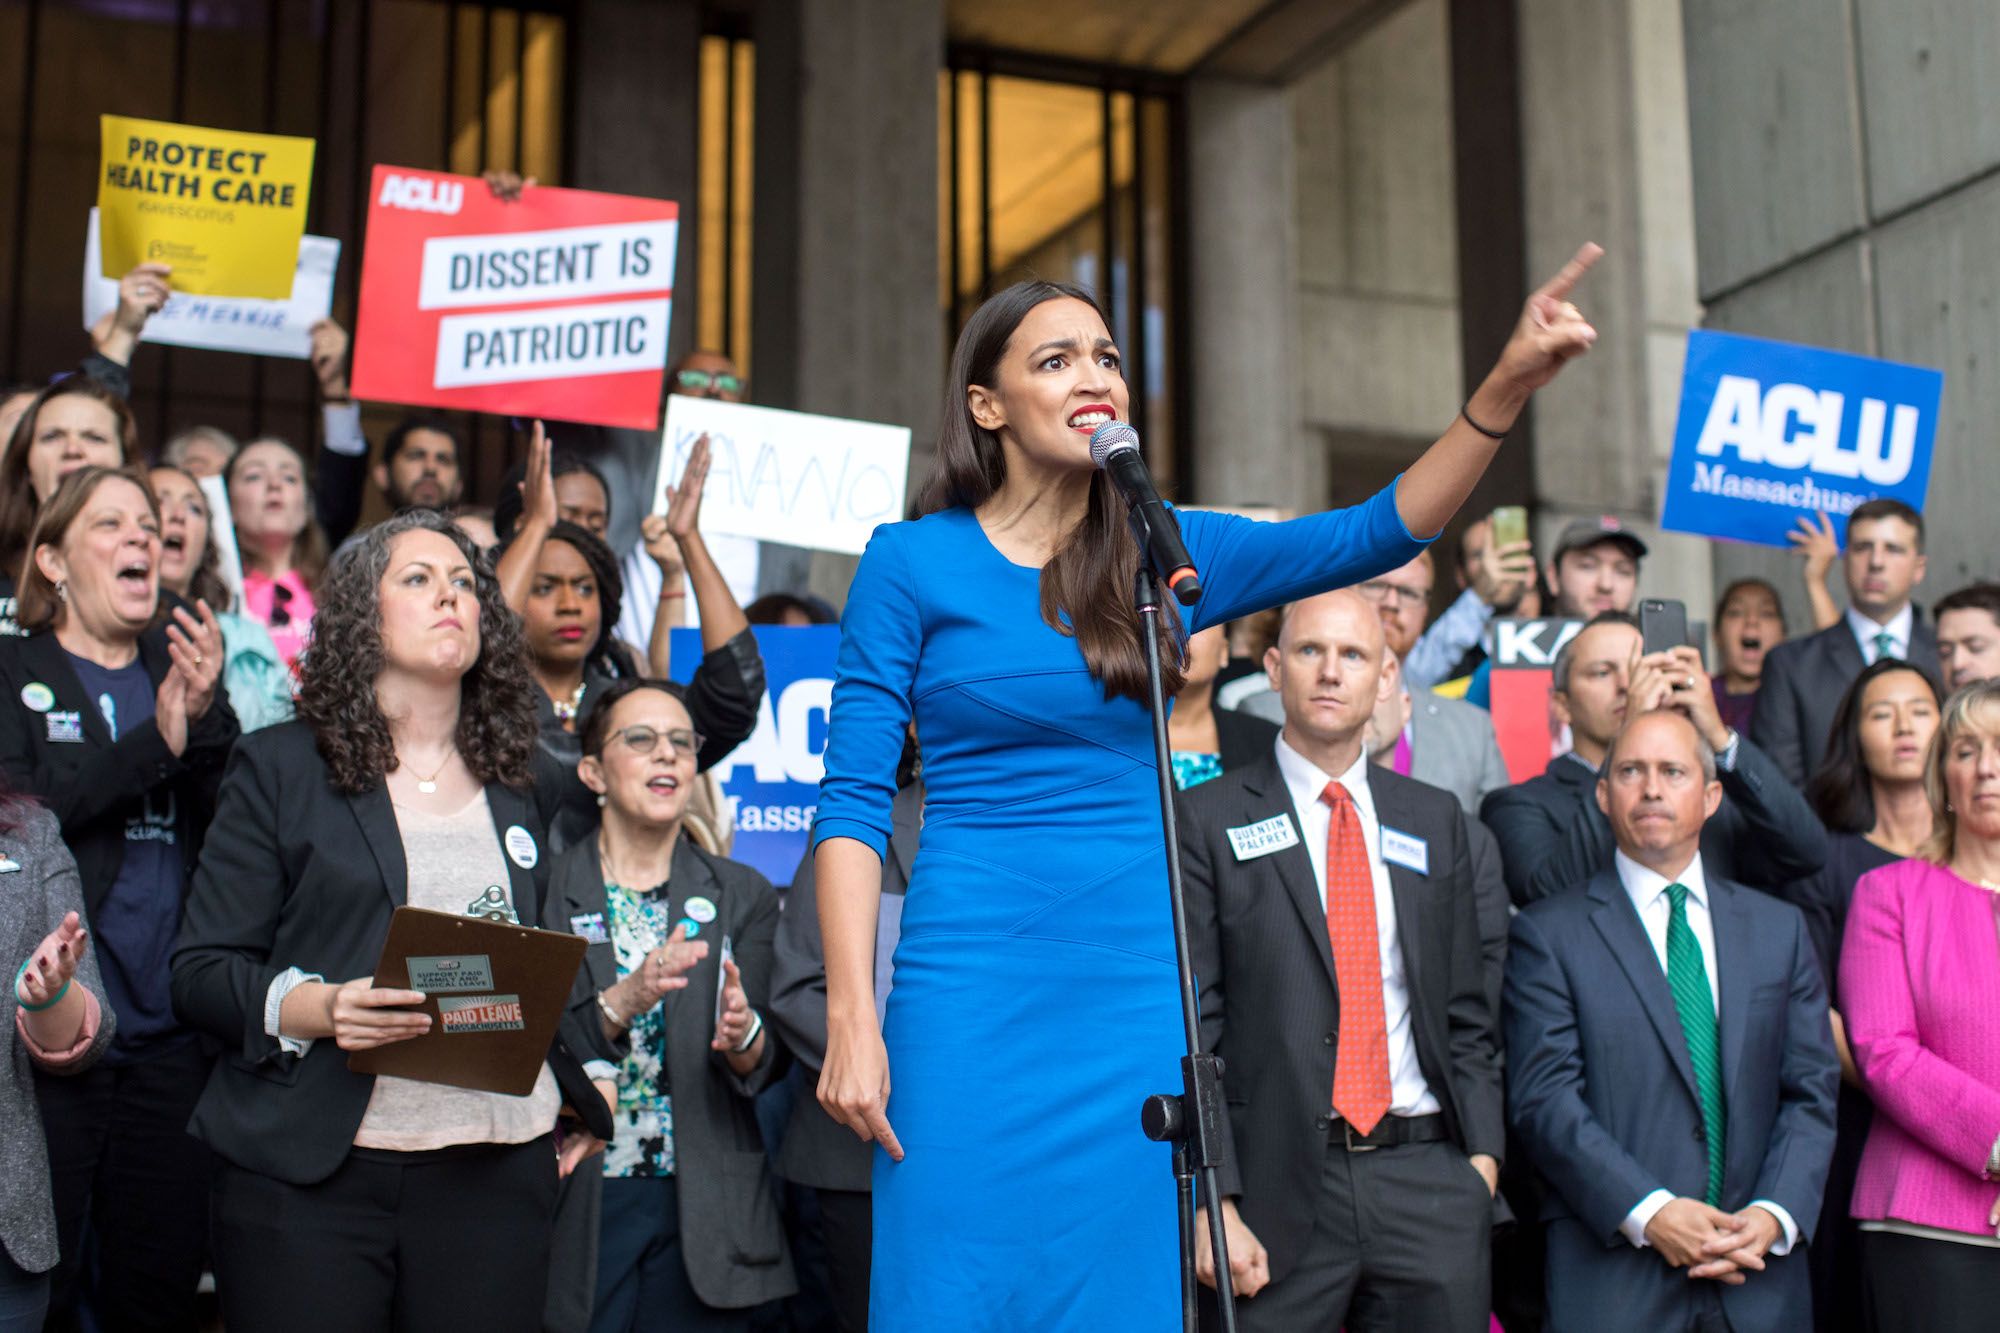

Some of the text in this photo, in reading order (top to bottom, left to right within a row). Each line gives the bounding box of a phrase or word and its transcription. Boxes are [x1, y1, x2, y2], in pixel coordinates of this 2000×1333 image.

[127, 137, 266, 175] PROTECT
[106, 163, 296, 208] HEALTH CARE
[379, 174, 464, 216] ACLU
[450, 238, 654, 293] DISSENT IS
[463, 316, 648, 370] PATRIOTIC
[1696, 374, 1919, 486] ACLU
[1691, 461, 1872, 516] Massachus
[709, 678, 836, 784] AC
[1234, 819, 1285, 841] QUENTIN
[1238, 829, 1289, 852] PALFREY
[443, 1003, 522, 1024] PAID LEAVE
[447, 1021, 520, 1032] MASSACHUSETTS
